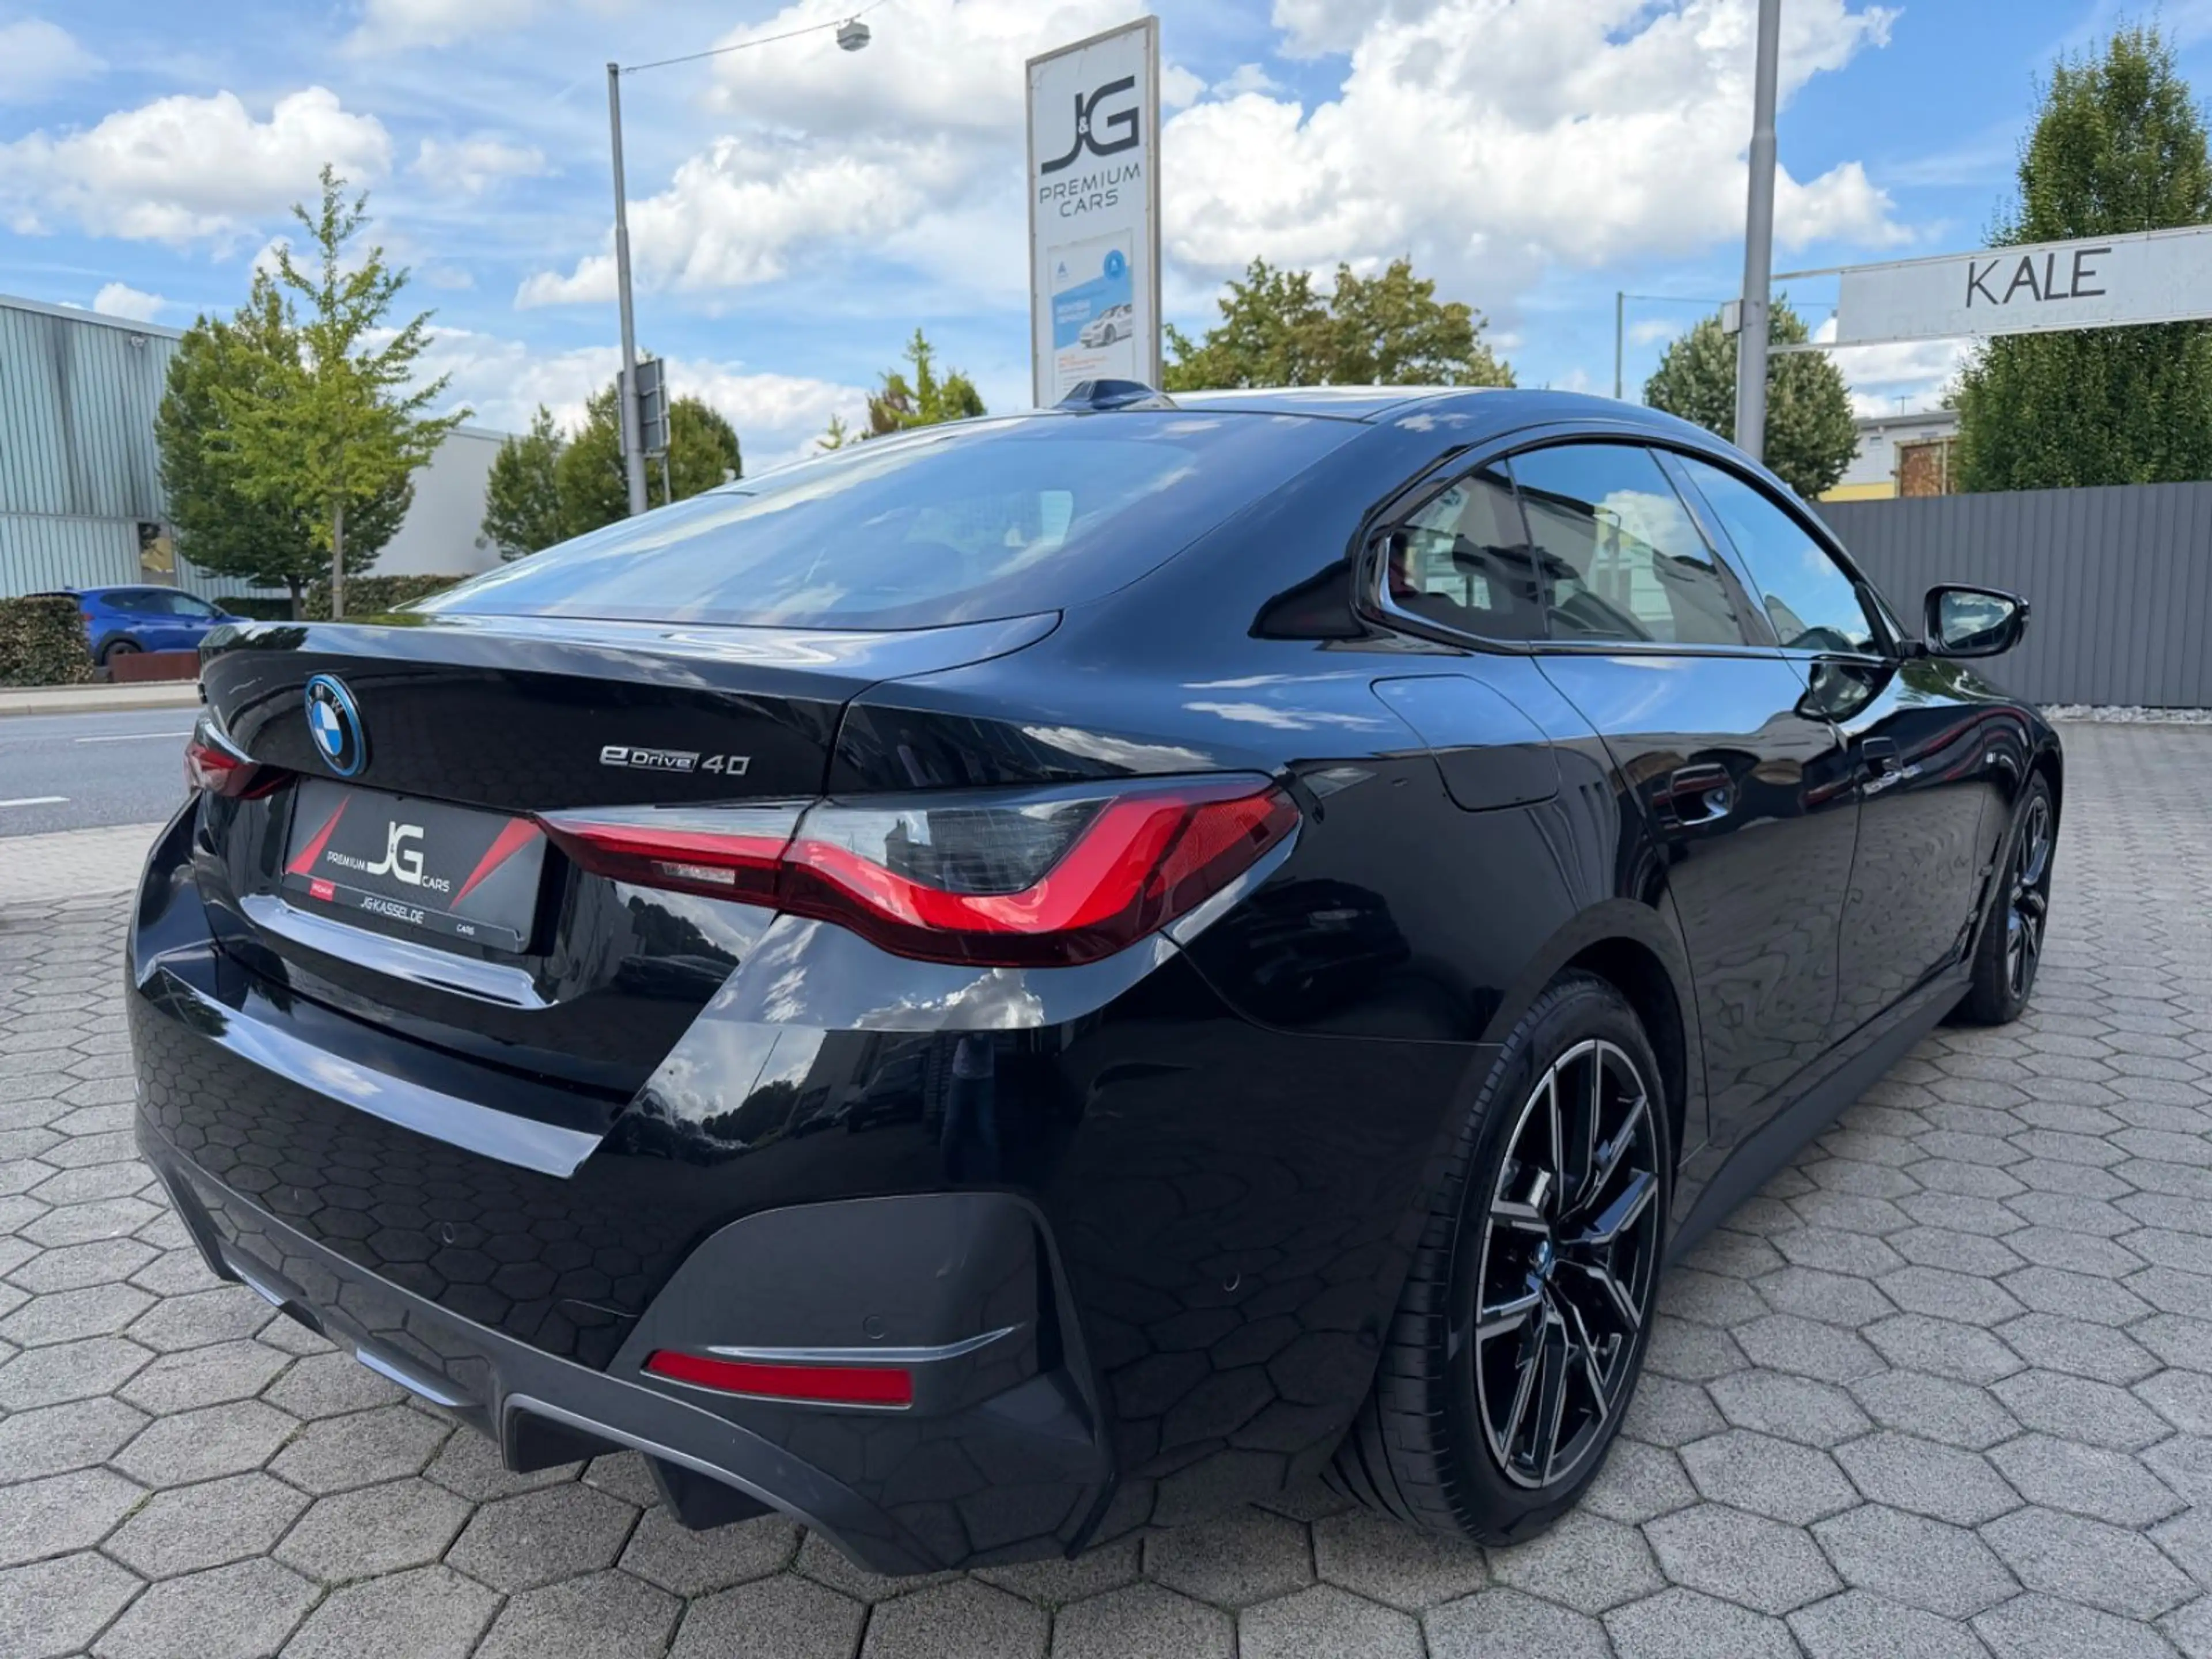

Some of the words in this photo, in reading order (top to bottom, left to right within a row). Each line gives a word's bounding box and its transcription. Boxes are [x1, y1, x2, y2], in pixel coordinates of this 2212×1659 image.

[1040, 164, 1141, 203] PREMIUM
[1060, 190, 1119, 218] CARS
[1966, 247, 2112, 308] KALE
[327, 850, 366, 870] PREMIUM
[422, 875, 450, 893] CARS
